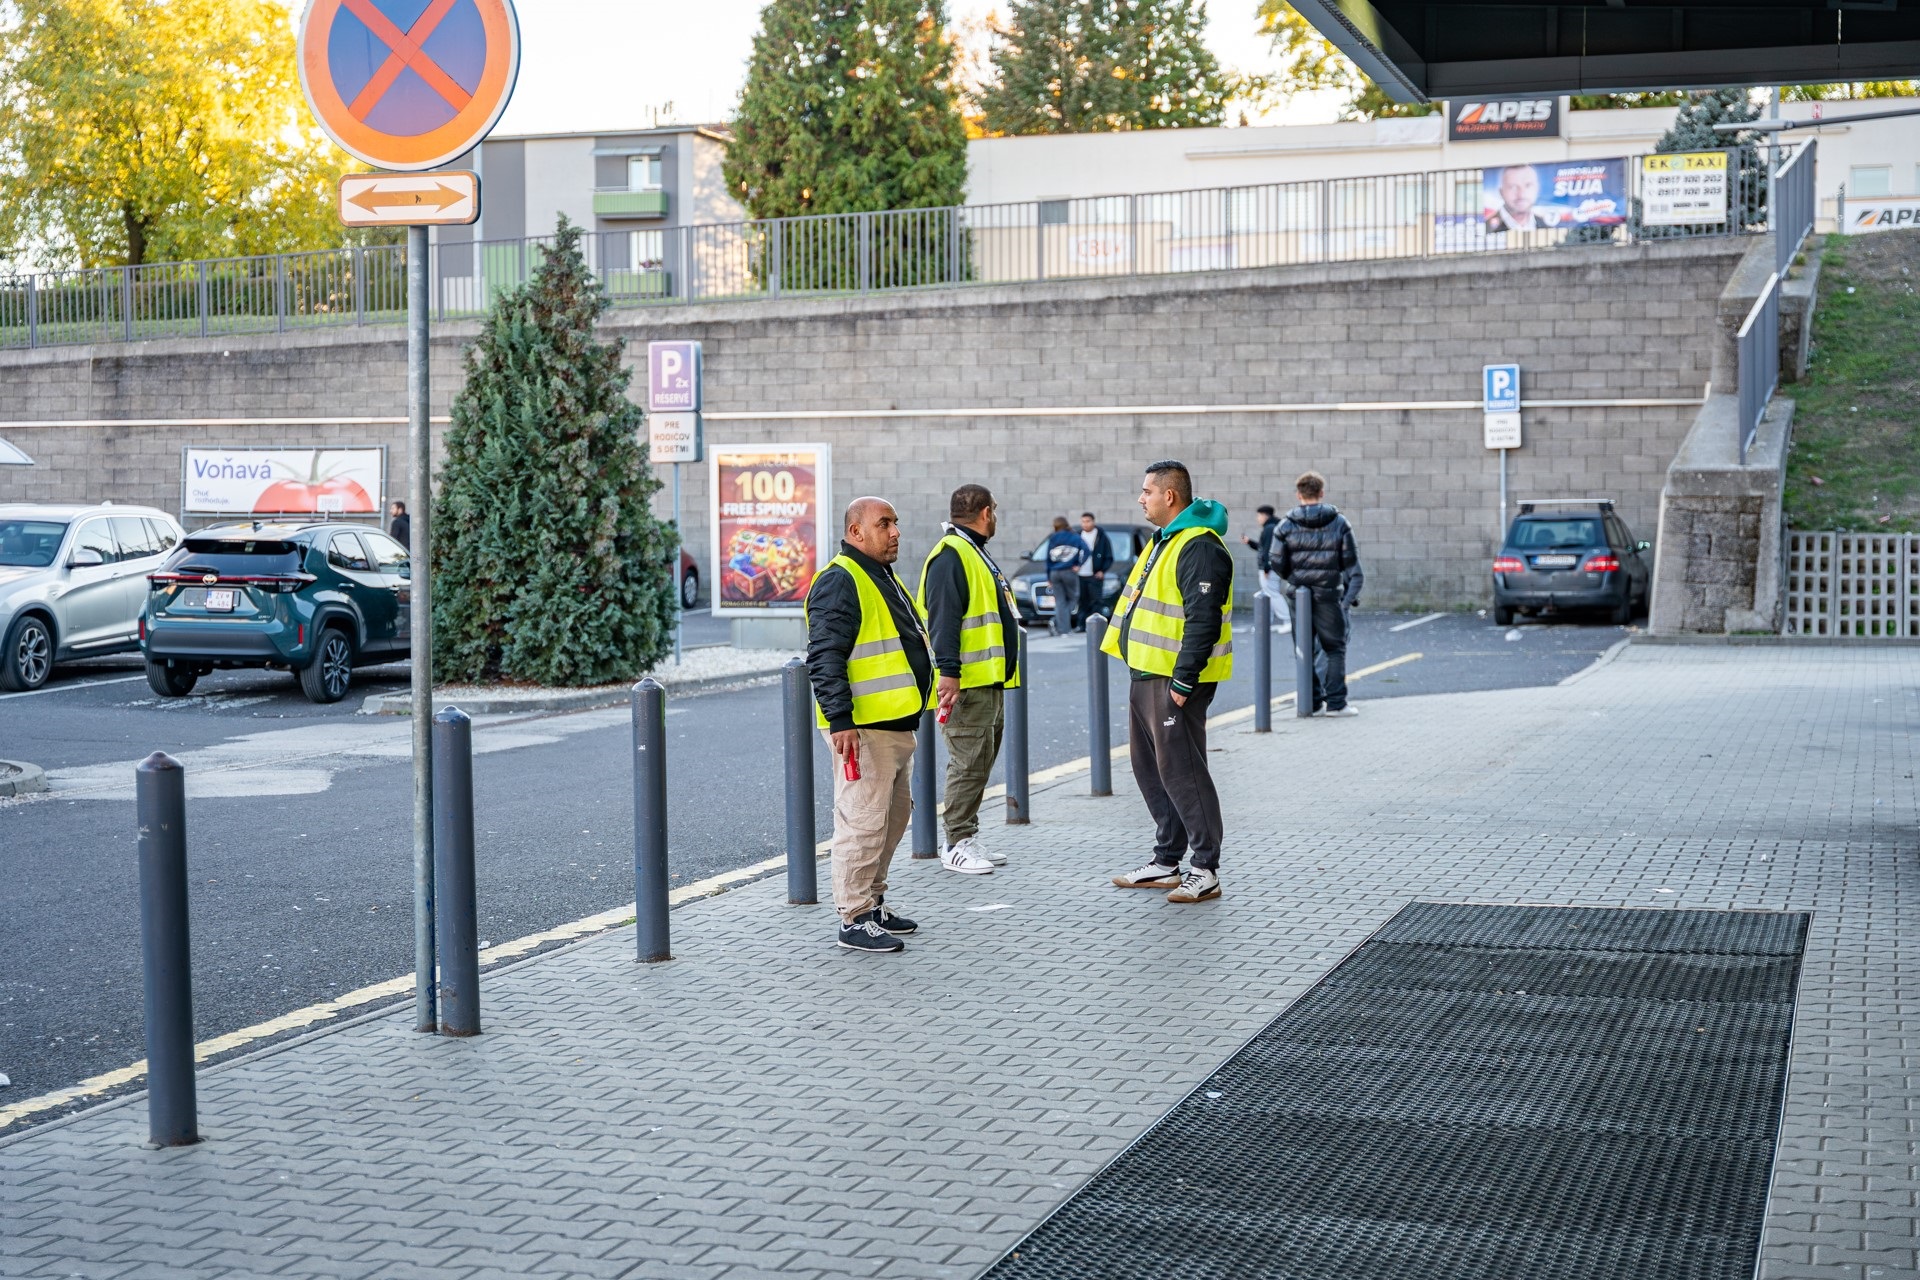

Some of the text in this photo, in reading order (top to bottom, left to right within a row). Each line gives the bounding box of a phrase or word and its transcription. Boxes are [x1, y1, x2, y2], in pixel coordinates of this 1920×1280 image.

[1479, 99, 1552, 123] APES
[661, 350, 681, 388] P
[1492, 370, 1510, 398] P
[664, 421, 680, 429] PRE
[194, 457, 272, 479] Voňavá
[735, 470, 795, 501] 100
[723, 502, 808, 517] FREE SPINOV
